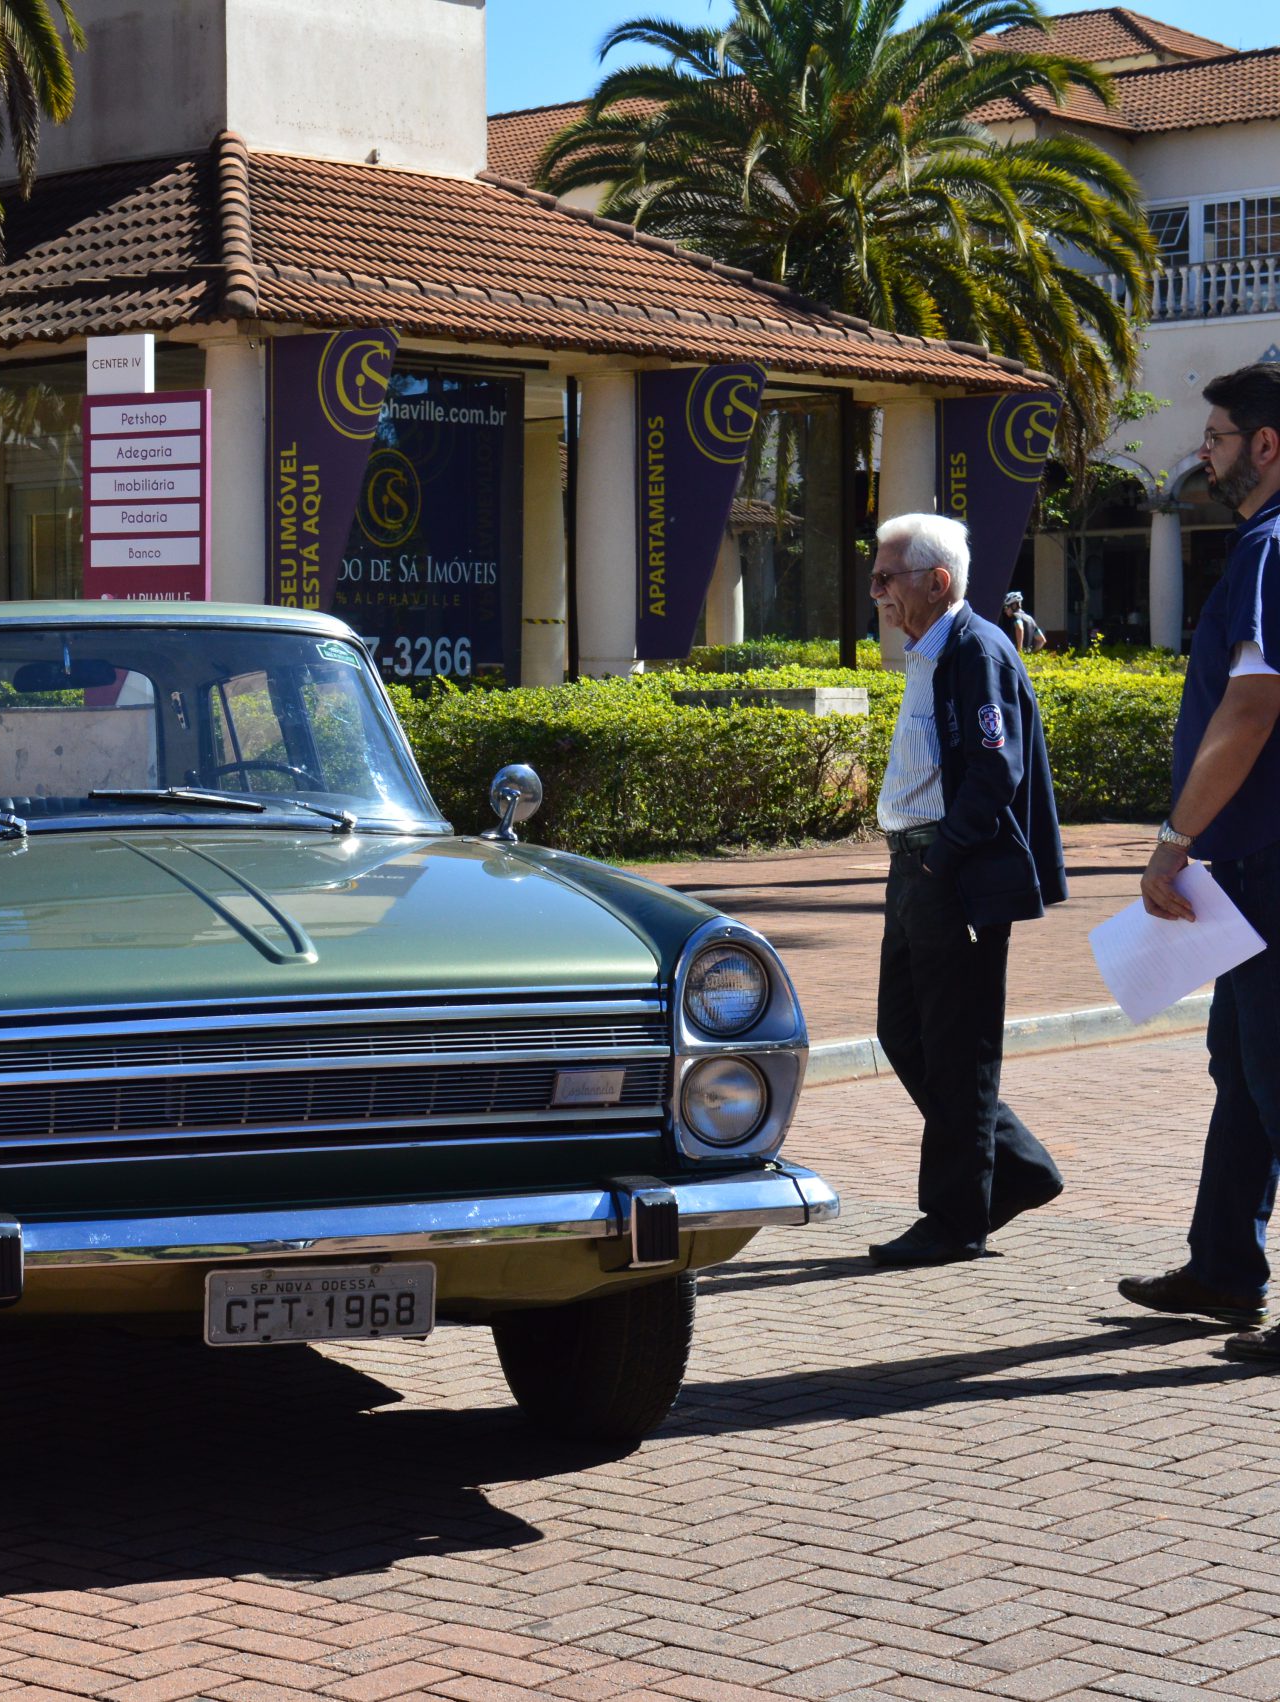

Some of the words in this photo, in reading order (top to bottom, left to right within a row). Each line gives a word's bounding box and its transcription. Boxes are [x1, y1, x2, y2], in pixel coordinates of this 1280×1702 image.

[92, 358, 129, 370] CENTER
[131, 357, 142, 367] IV
[121, 411, 167, 425] Petshop
[116, 445, 172, 460] Adegaria
[114, 478, 175, 492] Imobiliária
[950, 451, 967, 521] LOTES
[277, 441, 297, 550] IMÓVEL
[302, 464, 322, 535] AQUI
[121, 511, 168, 524] Padaria
[648, 415, 666, 617] APARTAMENTOS
[128, 547, 162, 559] Banco
[299, 542, 320, 610] ESTÁ
[370, 558, 392, 583] DE
[426, 554, 497, 585] IMÓVEIS
[280, 558, 297, 608] SEU
[354, 591, 462, 607] ALPHAVILLE
[250, 1283, 269, 1294] SP
[276, 1282, 313, 1293] NOVA
[321, 1279, 376, 1291] ODESSA
